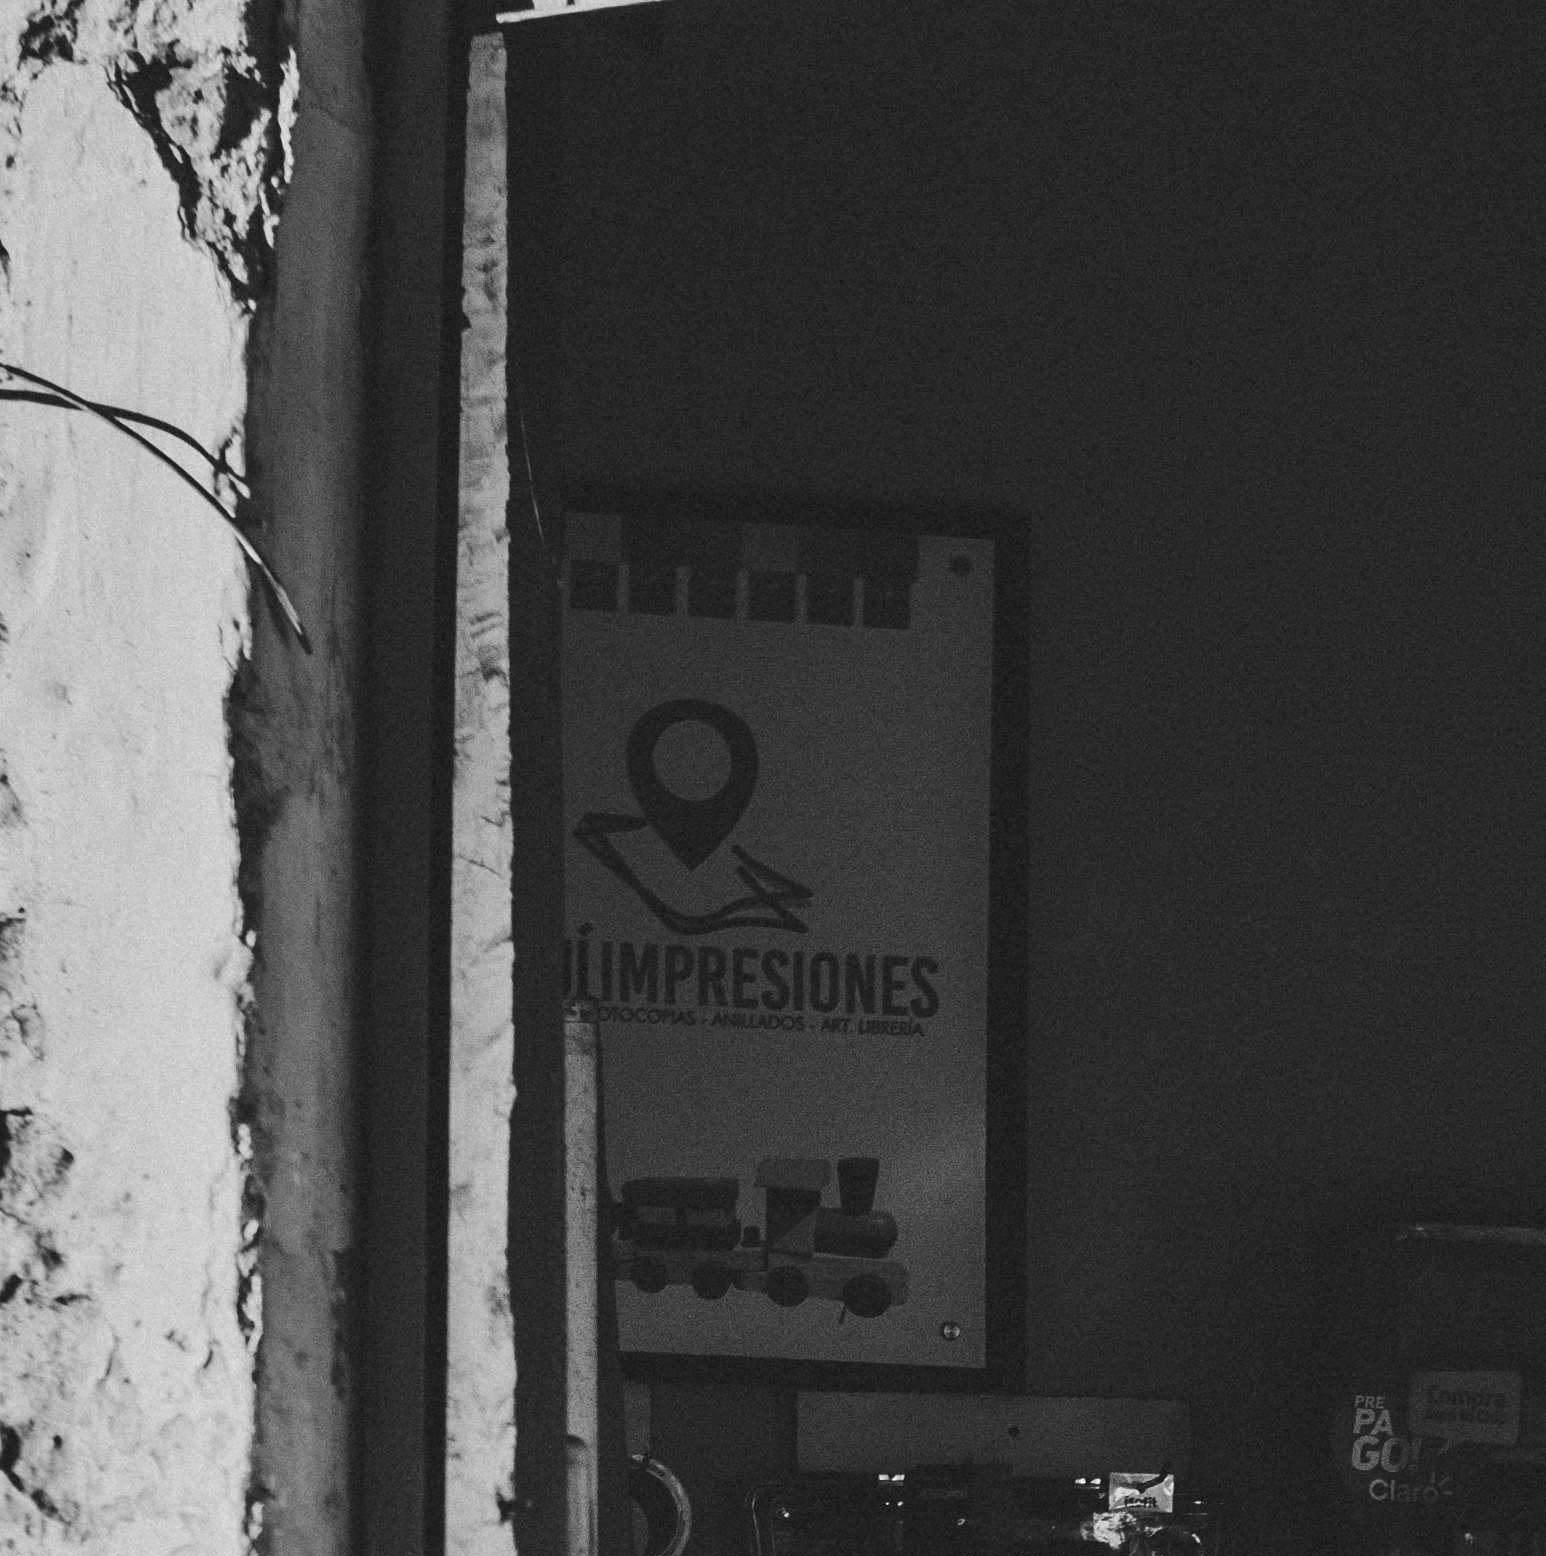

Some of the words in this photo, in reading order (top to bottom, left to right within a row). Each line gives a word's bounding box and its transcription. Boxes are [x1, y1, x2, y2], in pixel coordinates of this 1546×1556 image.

[601, 942, 939, 1018] IMPRESIONES
[597, 1005, 696, 1026] OTOCOPIAS
[711, 1012, 804, 1031] ANILLADOS
[858, 1018, 925, 1037] LIBRERÍA
[1354, 1394, 1386, 1409] PRE
[1353, 1408, 1394, 1436] PA
[1351, 1435, 1423, 1473] GO!
[1368, 1477, 1440, 1503] Claro
